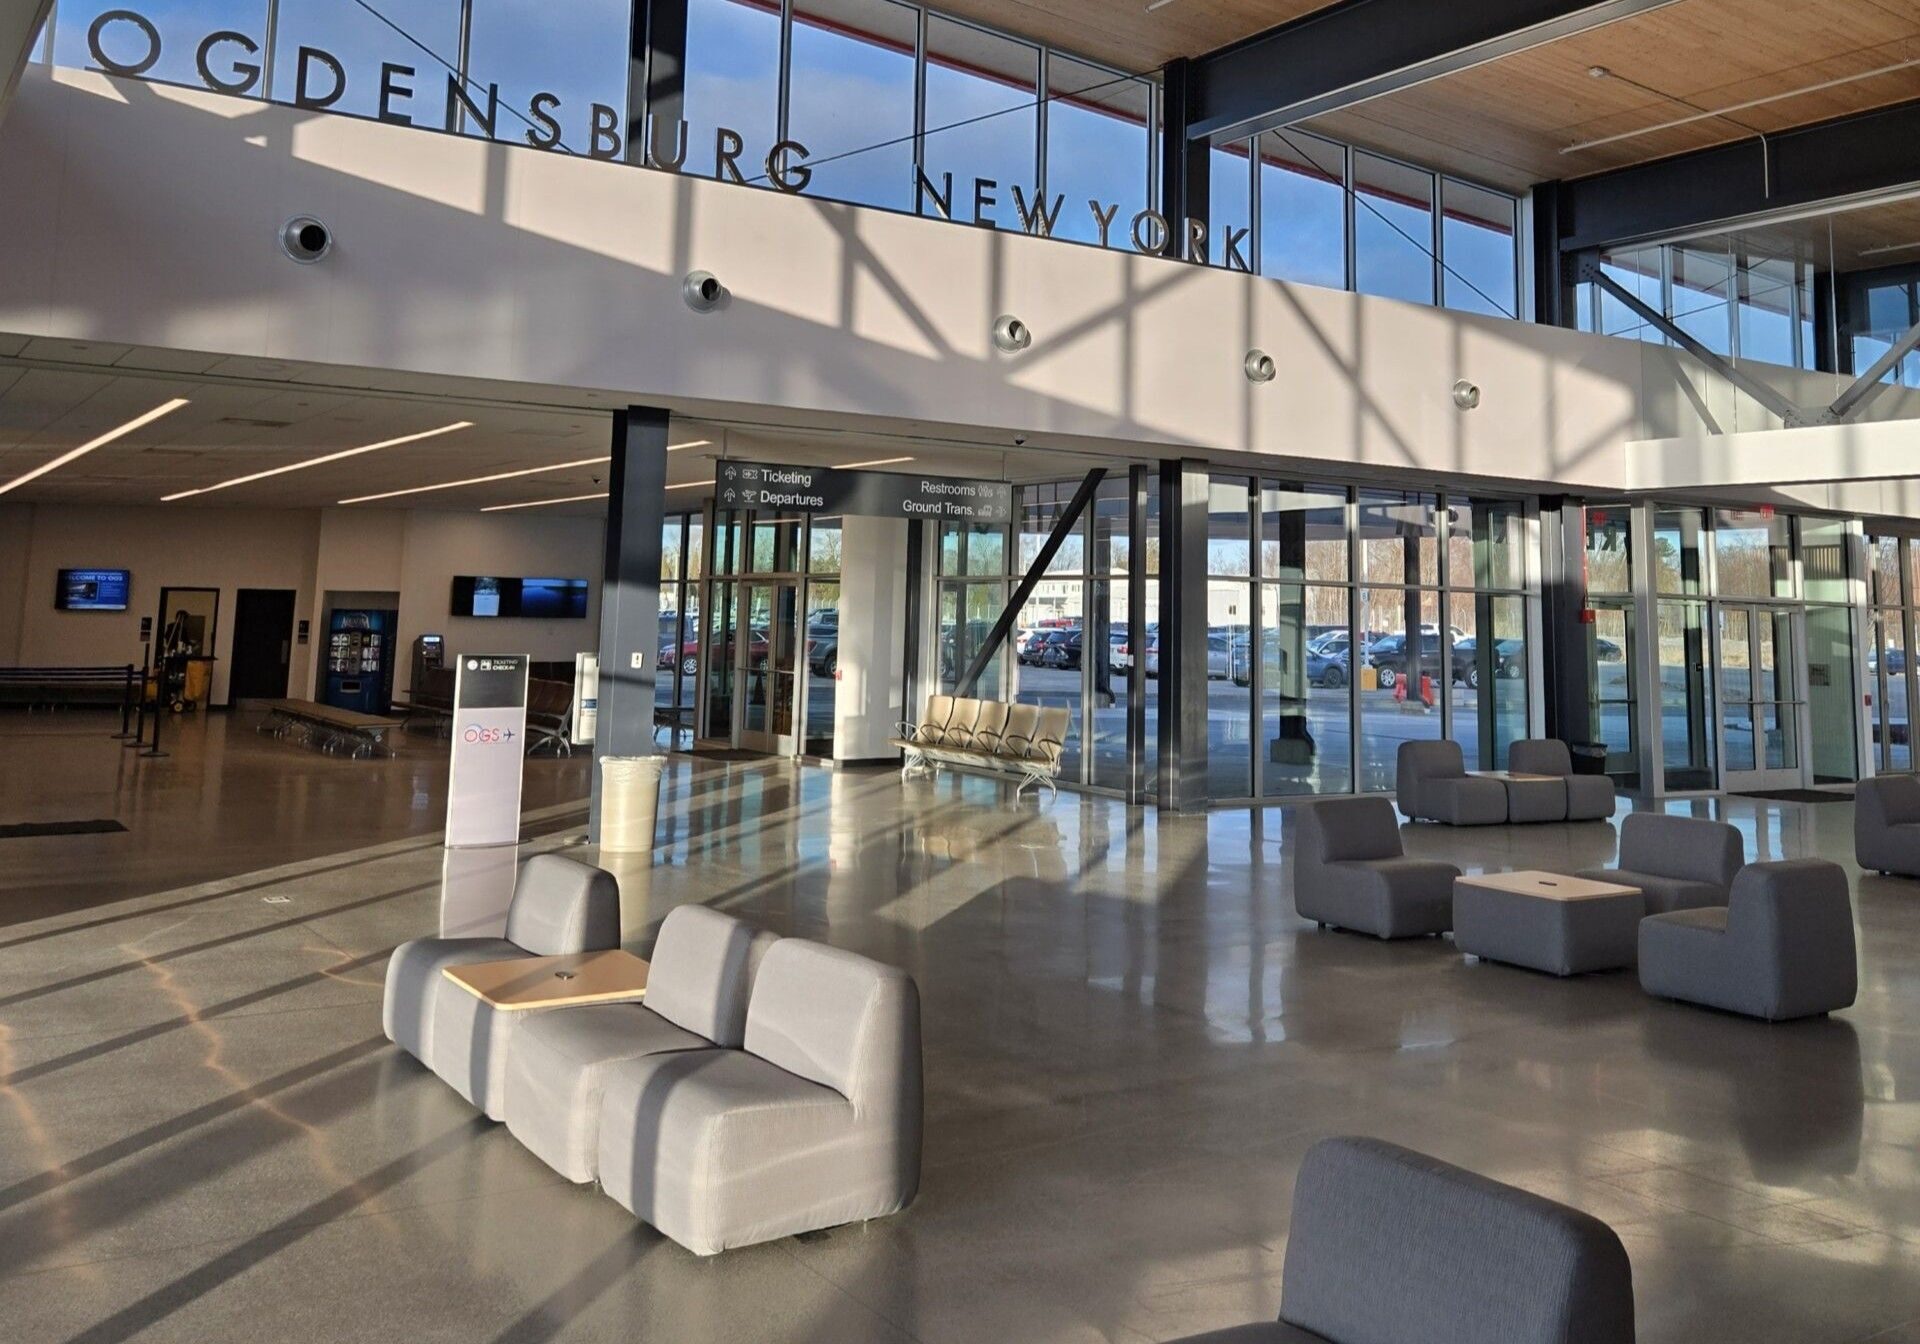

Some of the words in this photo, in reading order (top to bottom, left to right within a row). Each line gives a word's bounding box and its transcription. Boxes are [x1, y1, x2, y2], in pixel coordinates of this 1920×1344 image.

[86, 9, 813, 194] OGDENSBURG
[913, 163, 1066, 238] NEW
[1088, 199, 1252, 274] YORK
[761, 468, 812, 486] Ticketing
[921, 481, 976, 497] Restrooms
[760, 490, 824, 507] Departures
[903, 499, 941, 513] Ground
[943, 502, 975, 516] Trans.
[464, 728, 499, 742] OGS
